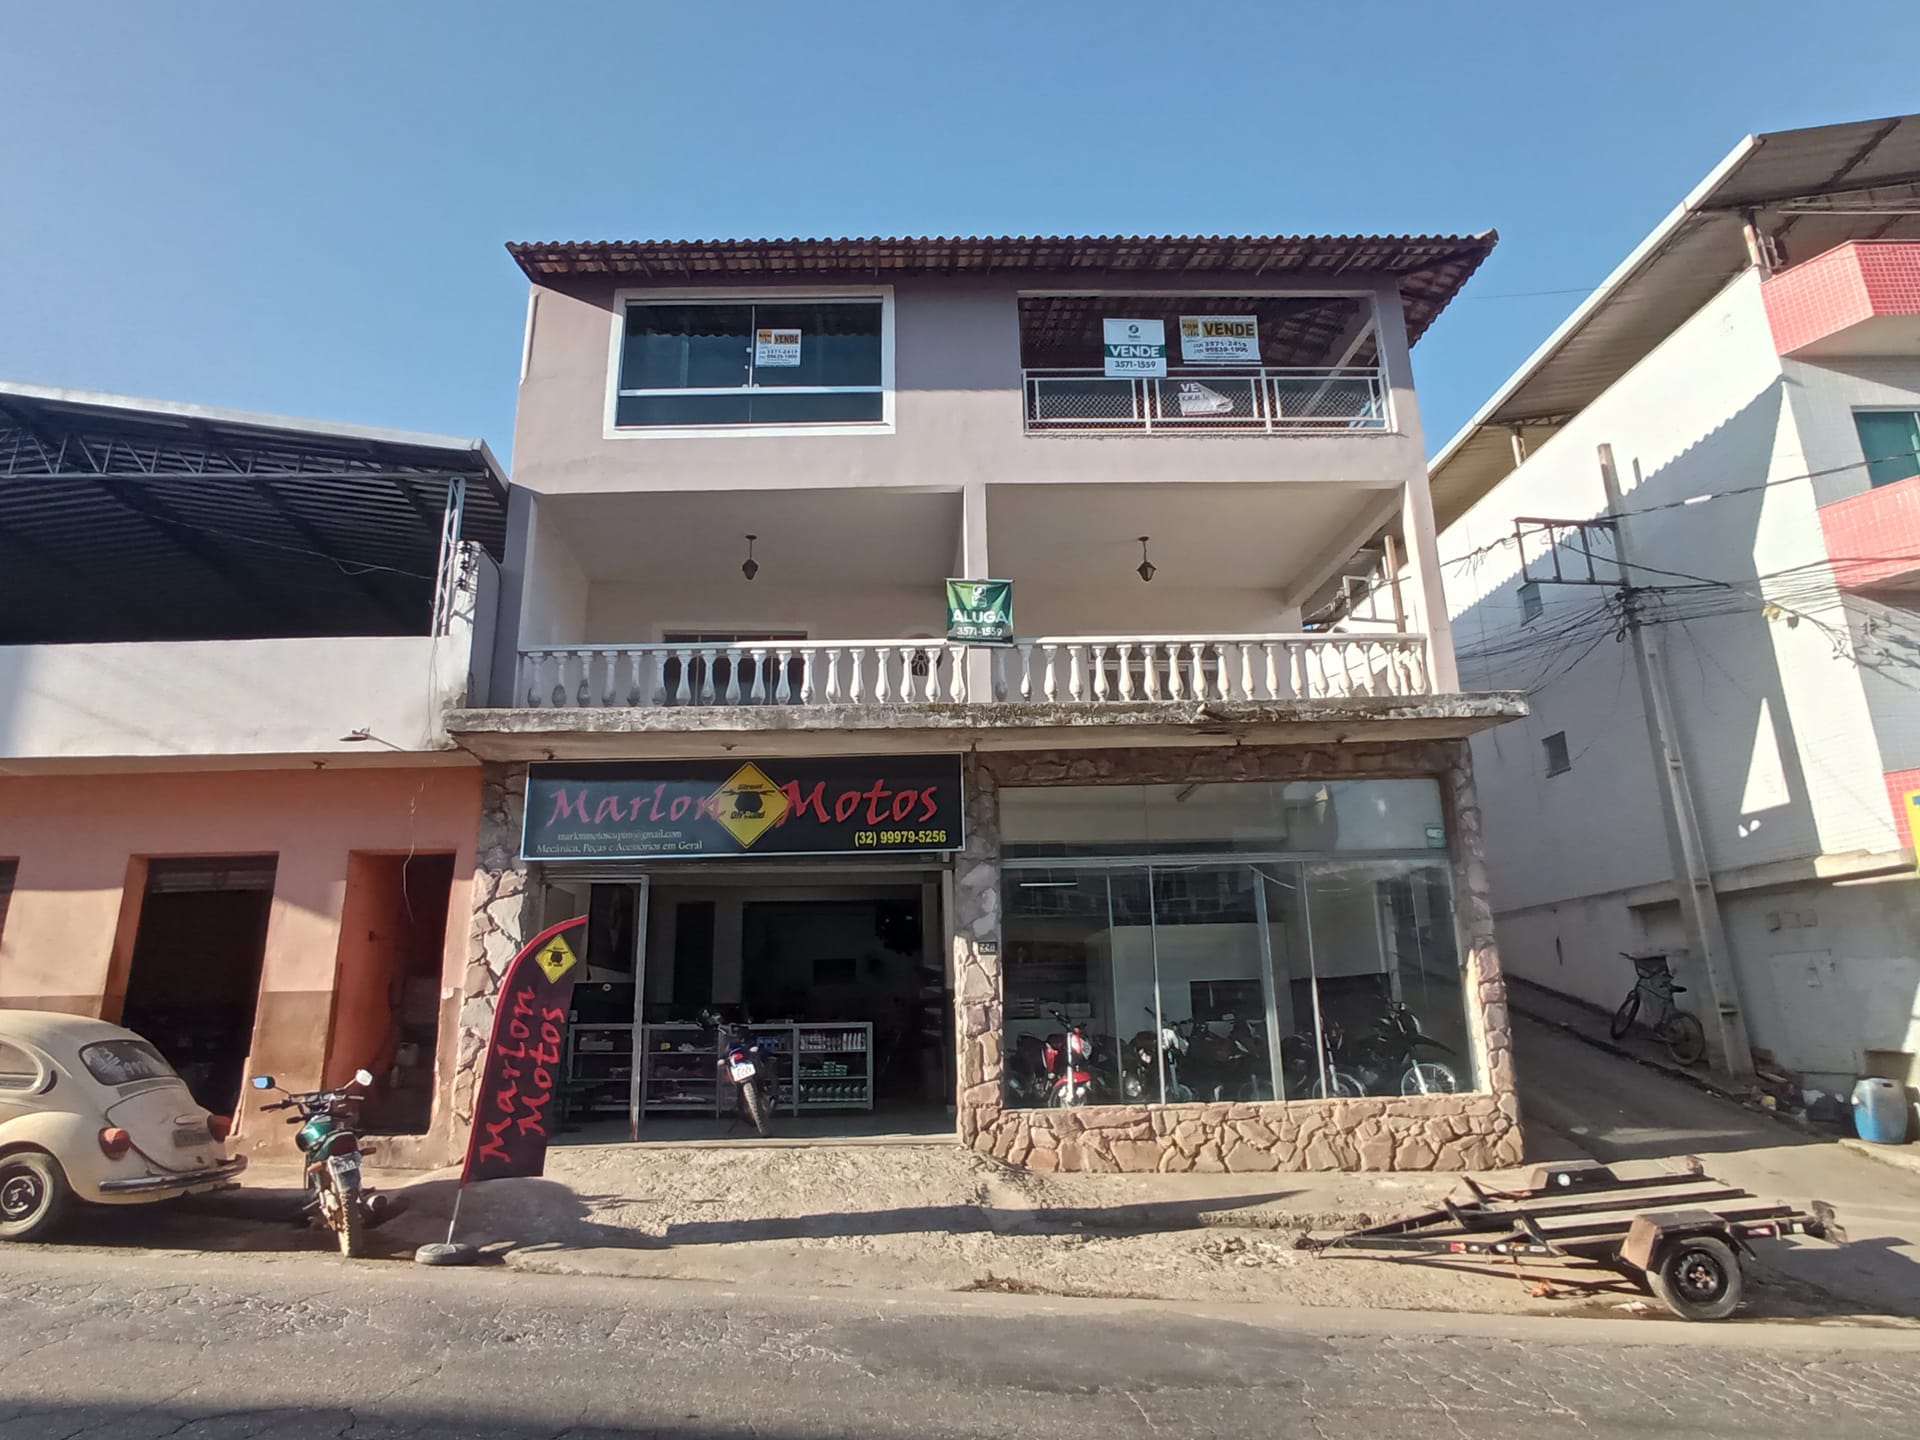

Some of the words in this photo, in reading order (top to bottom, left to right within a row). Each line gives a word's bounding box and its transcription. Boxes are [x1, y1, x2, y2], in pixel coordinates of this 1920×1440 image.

[1203, 321, 1255, 337] VENDE
[1110, 345, 1160, 357] VENDE
[1114, 360, 1157, 369] 3571-1559
[952, 608, 1009, 624] ALUGA
[956, 625, 1003, 637] 3571-1559
[545, 783, 726, 828] Marlon
[775, 778, 938, 829] Motos
[679, 840, 703, 851] Geral
[854, 831, 878, 847] (32)
[880, 830, 947, 844] 99979-5256
[479, 985, 535, 1163] Marlon
[517, 1005, 566, 1136] Motos
